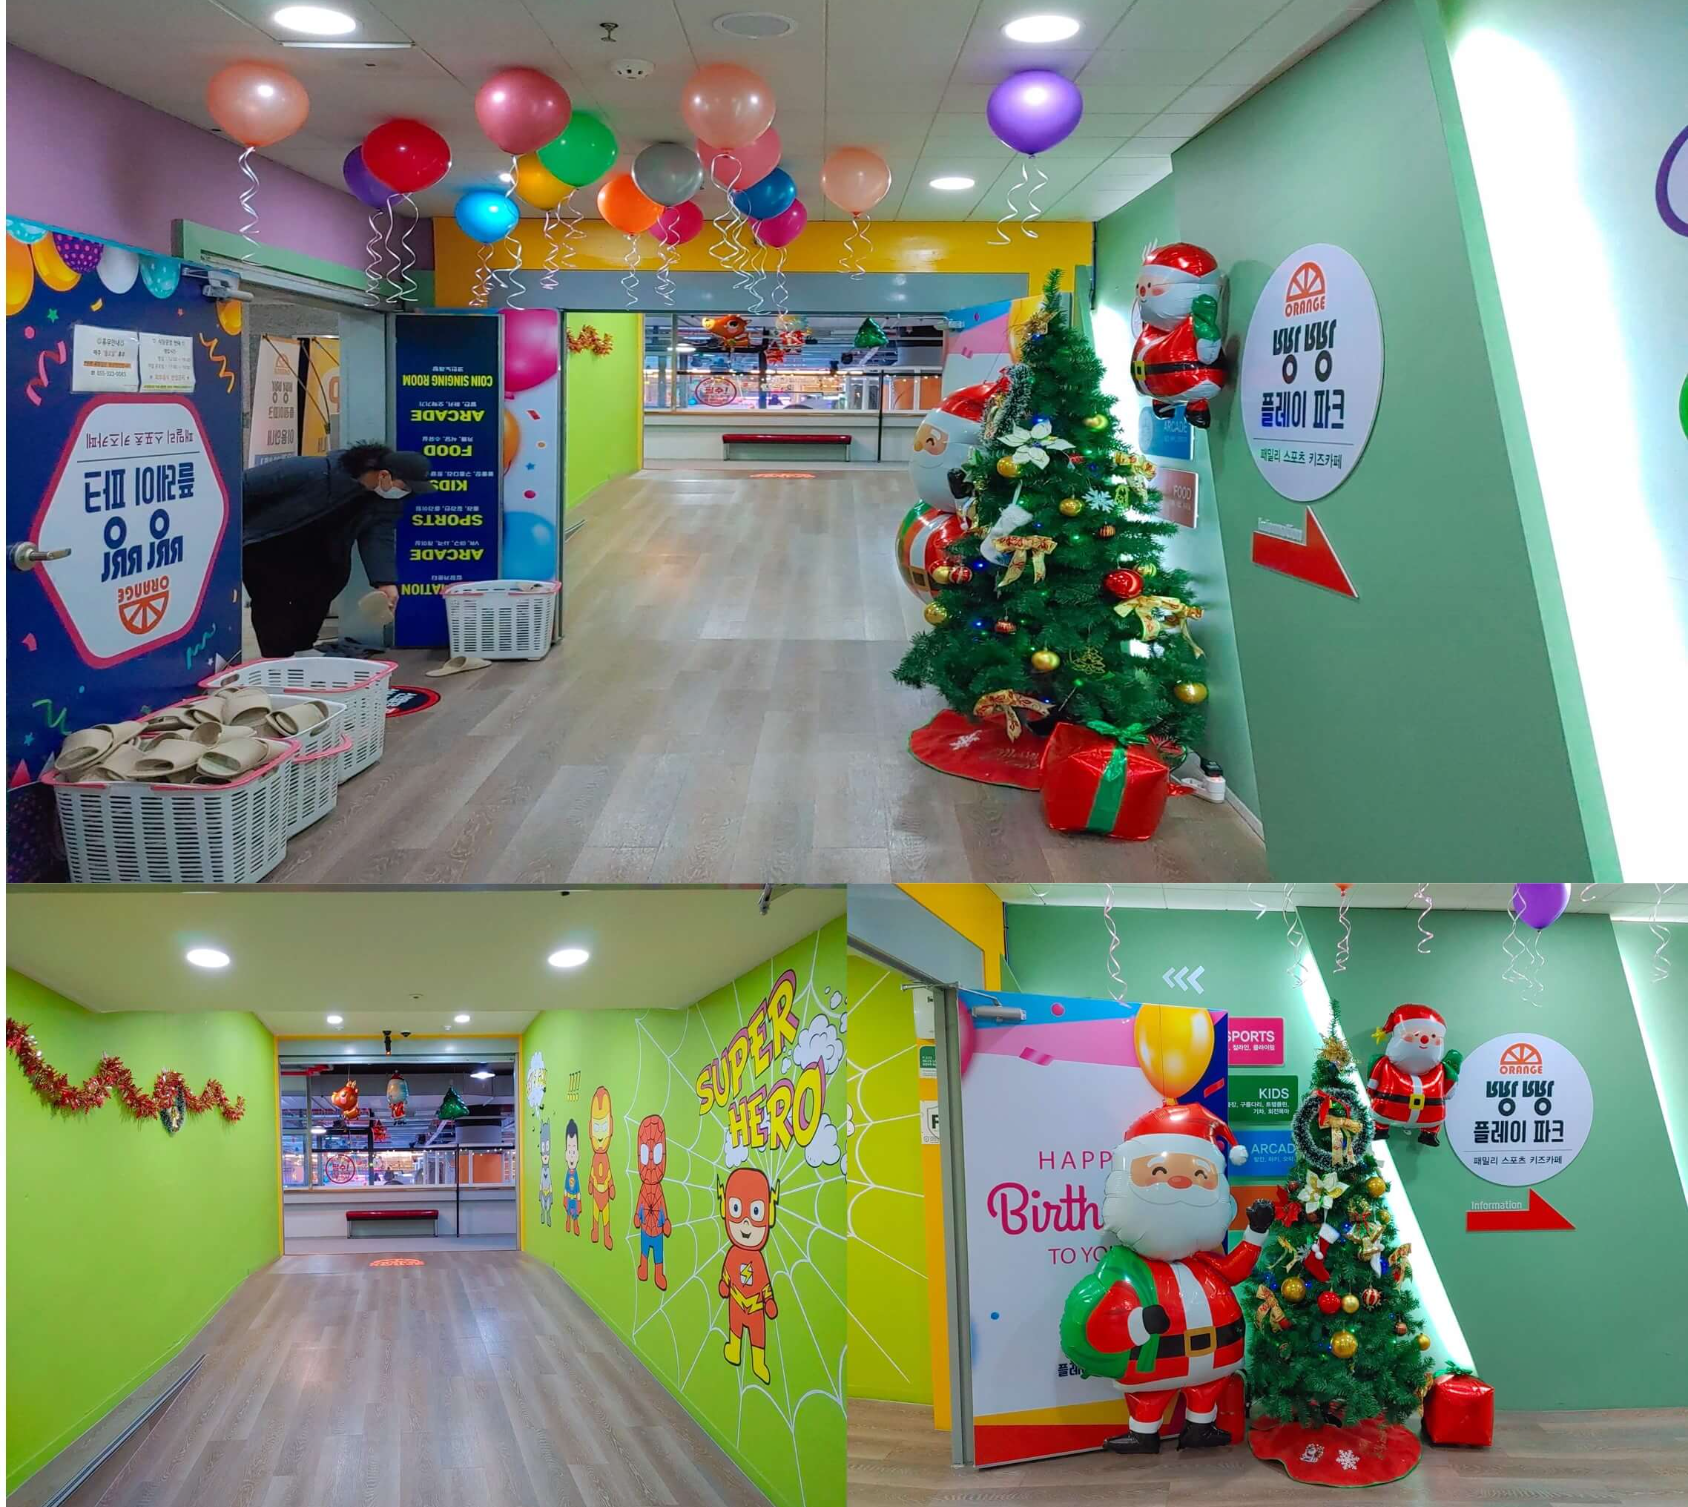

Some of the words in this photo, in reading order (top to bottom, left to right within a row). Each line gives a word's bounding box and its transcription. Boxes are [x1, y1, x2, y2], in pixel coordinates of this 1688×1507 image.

[1284, 294, 1327, 319] ORANGE
[402, 374, 430, 386] ROOM
[431, 375, 469, 387] SINGING
[471, 375, 493, 387] COIN
[411, 410, 485, 421] ARCADE
[1260, 390, 1307, 429] 플레이
[1313, 388, 1346, 430] 파크
[85, 432, 131, 449] 키즈카페
[134, 430, 164, 447] 스포츠
[167, 427, 193, 445] 패밀리
[423, 444, 473, 457] FOOD
[1260, 447, 1281, 464] 패밀리
[1283, 449, 1306, 466] 스포츠
[1308, 451, 1342, 470] 키즈카페
[84, 468, 126, 514] 파크
[135, 462, 195, 506] 플레이
[1173, 485, 1192, 500] FOOD
[411, 514, 483, 526] SPORTS
[409, 548, 484, 560] ARCADE
[117, 575, 170, 604] ORANGE
[401, 583, 445, 595] ATION
[695, 968, 800, 1116] SUPER
[1499, 1065, 1543, 1075] ORANGE
[1258, 1088, 1290, 1099] KIDS
[727, 1055, 826, 1152] HERO
[1473, 1120, 1527, 1144] 플레이
[1533, 1119, 1565, 1144] 파크
[1250, 1143, 1296, 1155] ARCAD
[1038, 1150, 1113, 1170] HAPP
[1473, 1156, 1499, 1166] 패밀리
[1500, 1156, 1526, 1165] 스포츠
[1529, 1155, 1563, 1165] 키즈카페
[987, 1181, 1104, 1236] Birth
[1470, 1200, 1523, 1210] Information
[1047, 1247, 1076, 1265] TO
[1080, 1245, 1113, 1263] YO
[1057, 1360, 1082, 1377] 플레
